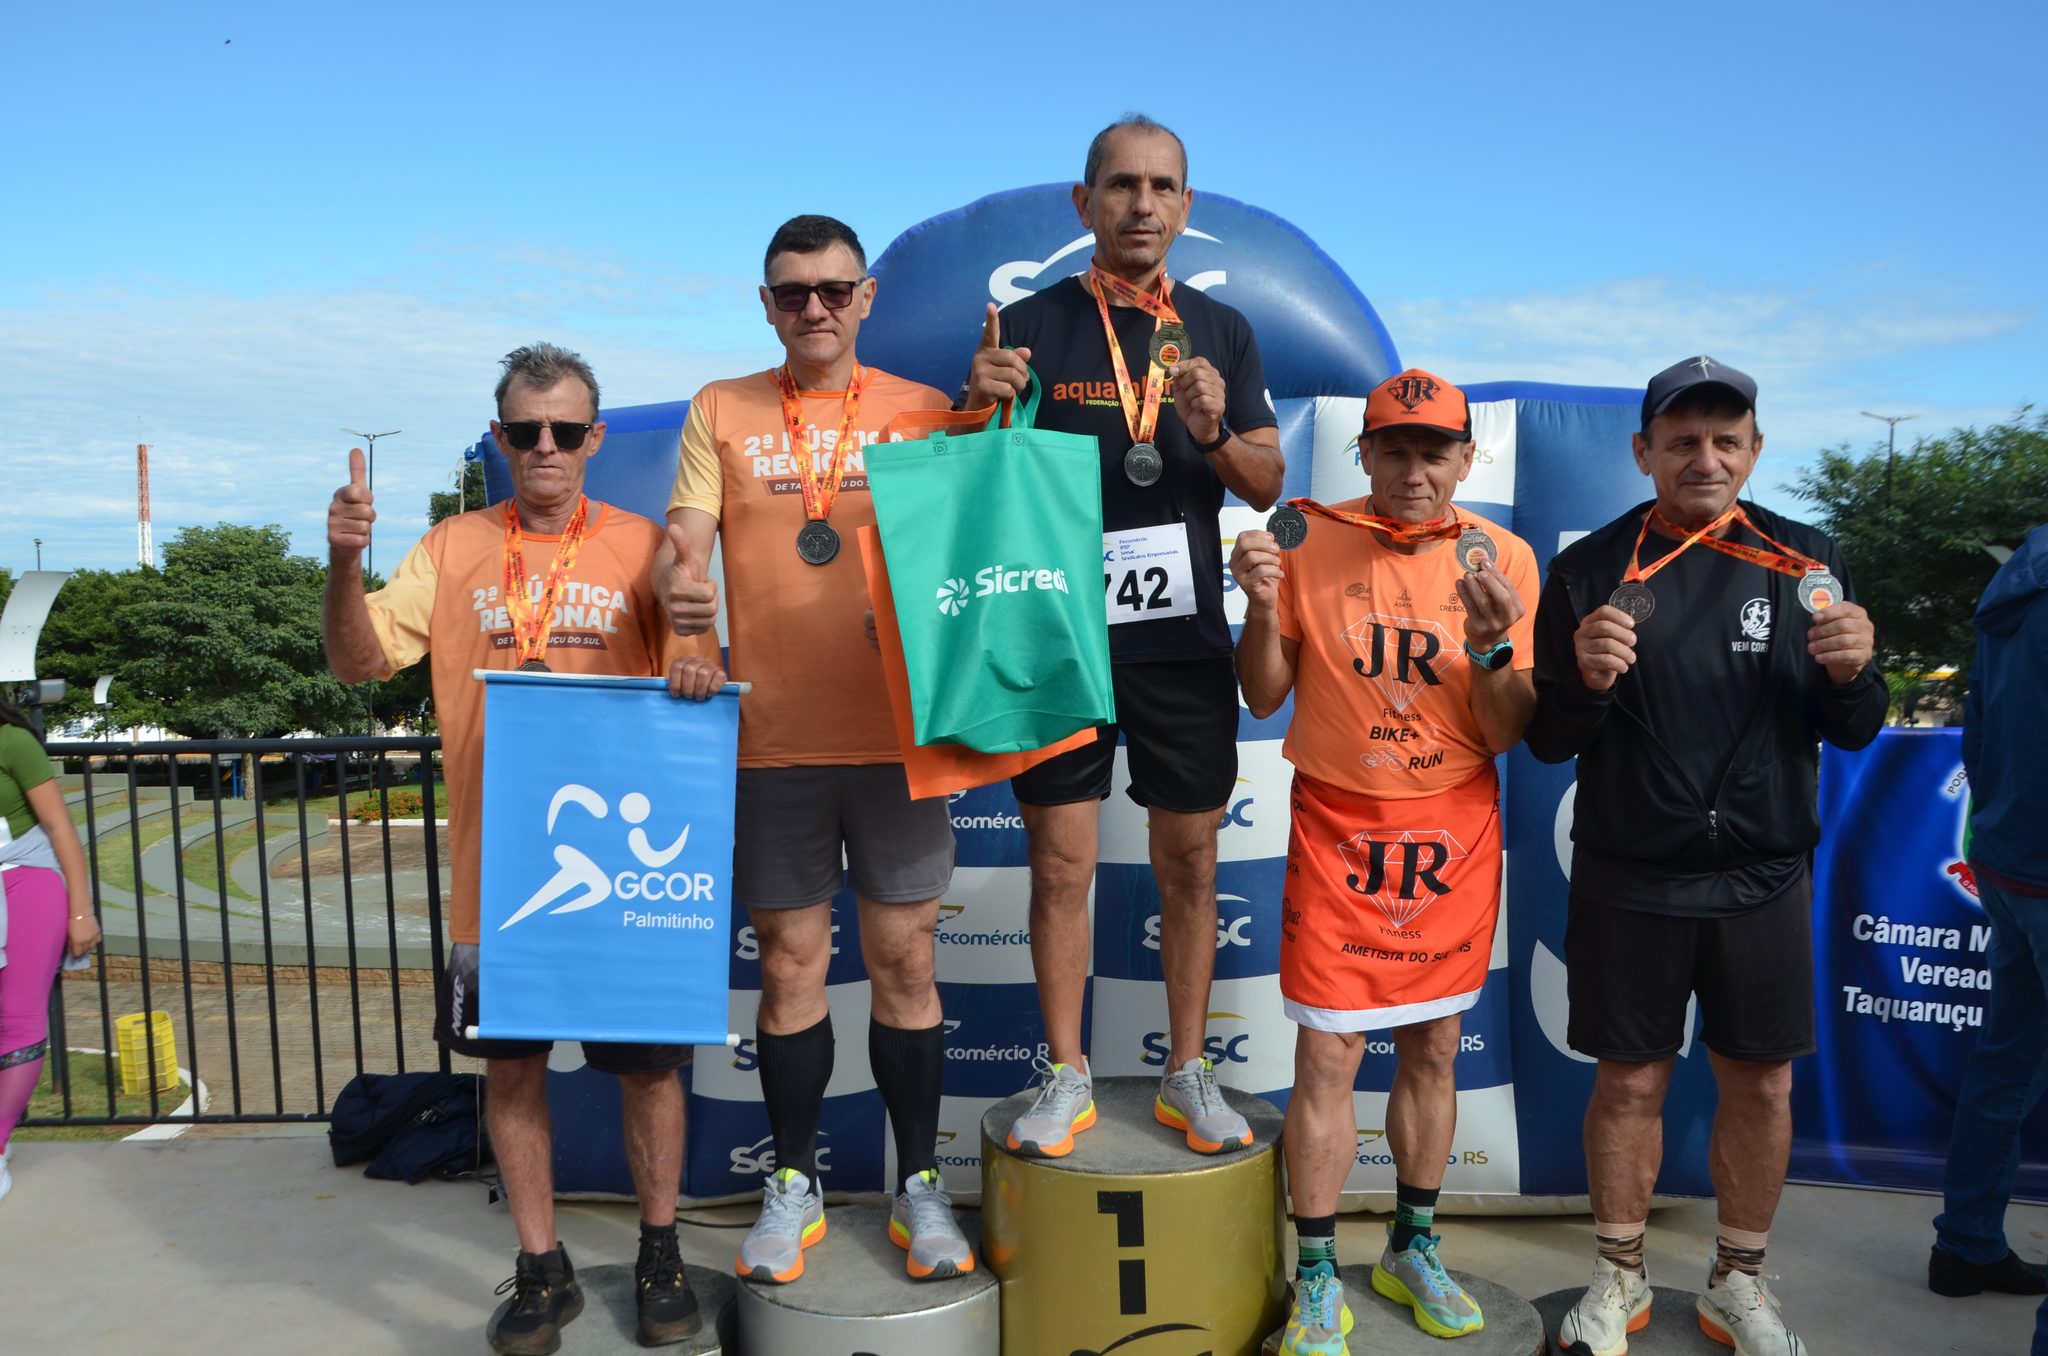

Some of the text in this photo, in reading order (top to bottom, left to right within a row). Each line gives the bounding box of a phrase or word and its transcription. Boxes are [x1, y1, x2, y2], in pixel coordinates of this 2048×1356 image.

[1395, 379, 1435, 401] JR
[849, 480, 864, 488] DO
[1353, 622, 1443, 686] JR
[1731, 641, 1750, 652] VEM
[1383, 708, 1423, 721] Fitness
[1369, 726, 1420, 743] BIKE+
[1408, 750, 1444, 770] RUN
[1345, 839, 1453, 900] JR
[614, 870, 714, 901] GCOR
[623, 910, 714, 930] Palmitinho
[1852, 914, 1961, 950] Câmara
[1341, 943, 1404, 961] AMETISTA
[1409, 952, 1428, 963] DO
[451, 974, 465, 1037] NIKE
[1843, 985, 1984, 1032] Taquaruçu
[1461, 1034, 1485, 1053] RS
[1463, 1150, 1489, 1165] RS
[1097, 1190, 1147, 1315] 1
